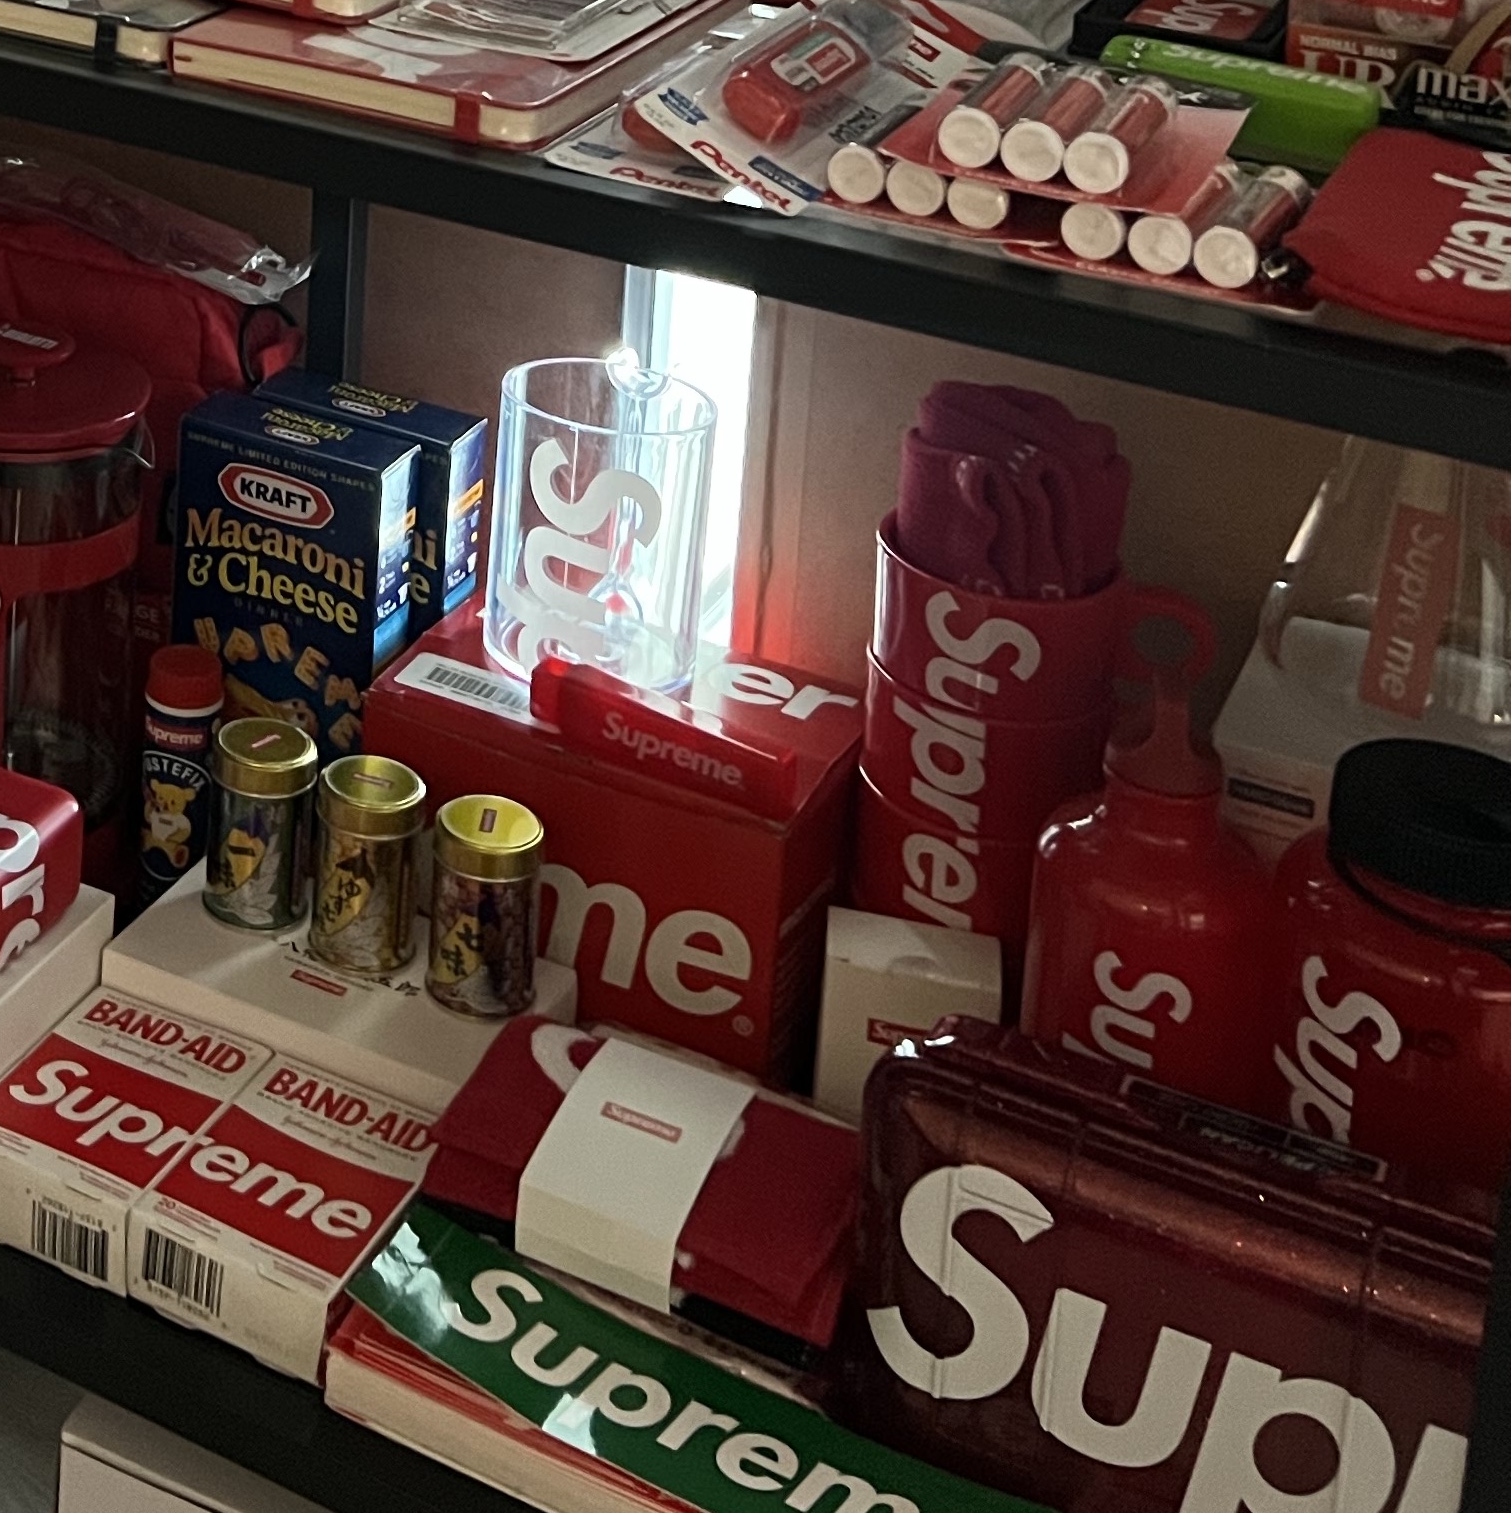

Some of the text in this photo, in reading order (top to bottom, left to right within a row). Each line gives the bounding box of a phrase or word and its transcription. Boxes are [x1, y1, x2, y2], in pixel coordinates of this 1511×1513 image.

[1299, 34, 1398, 61] NORMAL BIAS
[238, 444, 283, 467] LIMITED
[283, 458, 328, 480] EDITION
[239, 477, 312, 516] KRAFT
[185, 507, 366, 600] Macaroni
[187, 553, 213, 586] &
[217, 552, 359, 635] Cheese
[1379, 522, 1445, 701] Suprme
[145, 714, 204, 746] Supreme
[602, 711, 743, 787] Supreme
[84, 997, 248, 1076] BAND-AID
[1062, 949, 1193, 1070] Su
[8, 1059, 372, 1239] Supreme
[262, 1066, 437, 1153] BAND-AID
